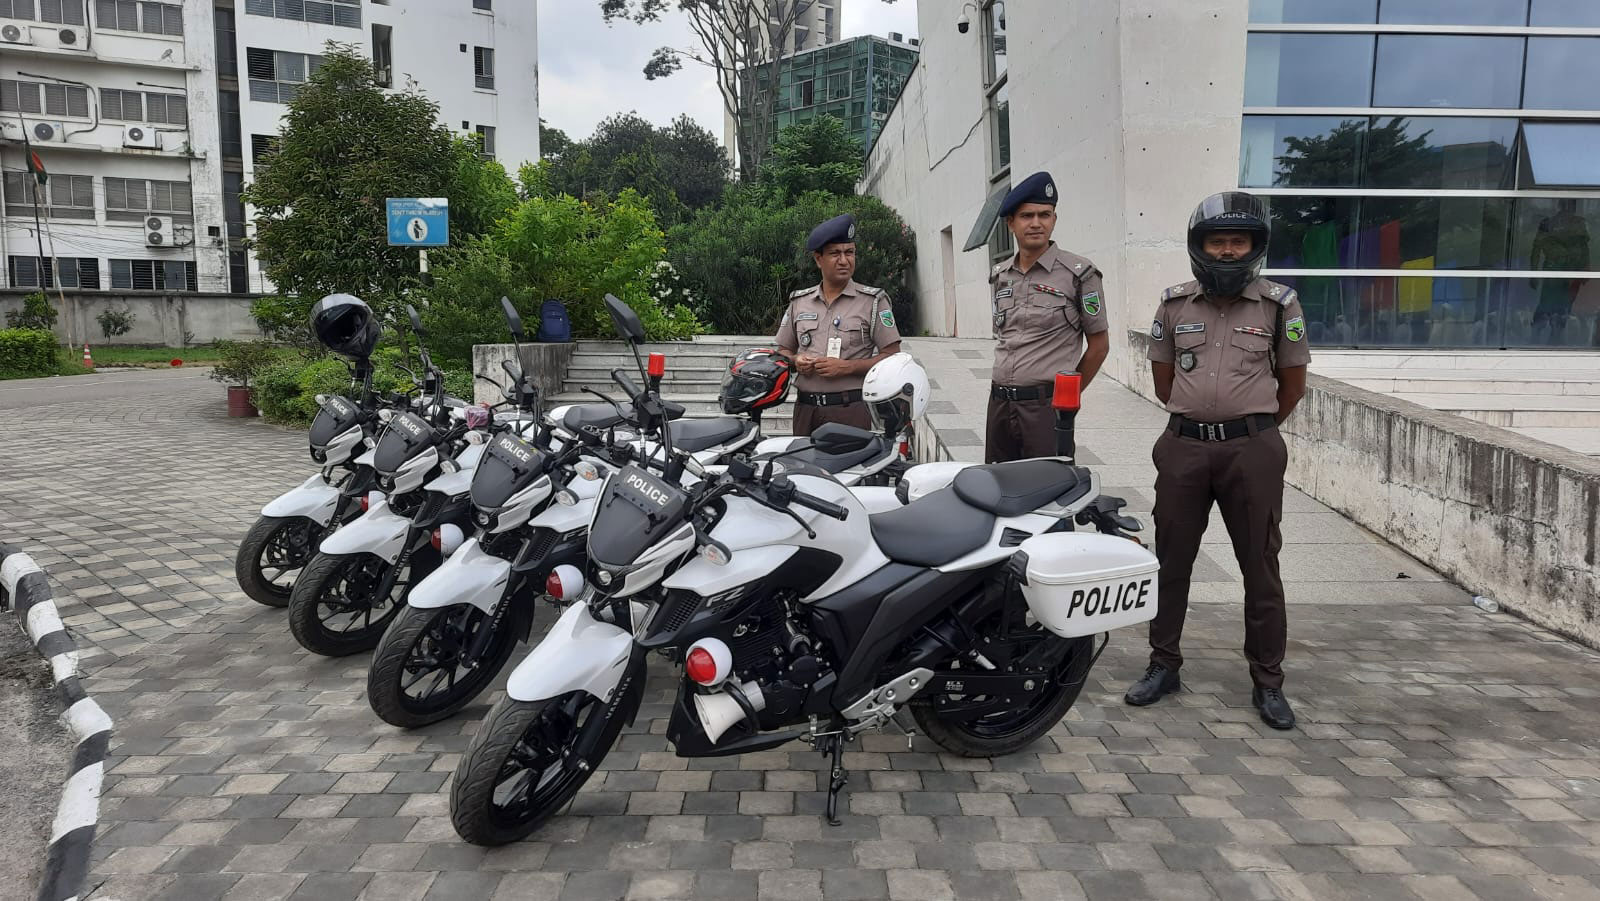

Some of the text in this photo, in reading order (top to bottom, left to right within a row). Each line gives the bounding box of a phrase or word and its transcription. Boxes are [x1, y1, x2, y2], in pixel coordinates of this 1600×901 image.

[330, 398, 348, 415] POLICE
[399, 415, 421, 436] POLICE
[500, 438, 530, 463] POLICE
[627, 474, 669, 506] POLICE
[706, 586, 745, 607] FZ
[1066, 579, 1152, 618] POLICE
